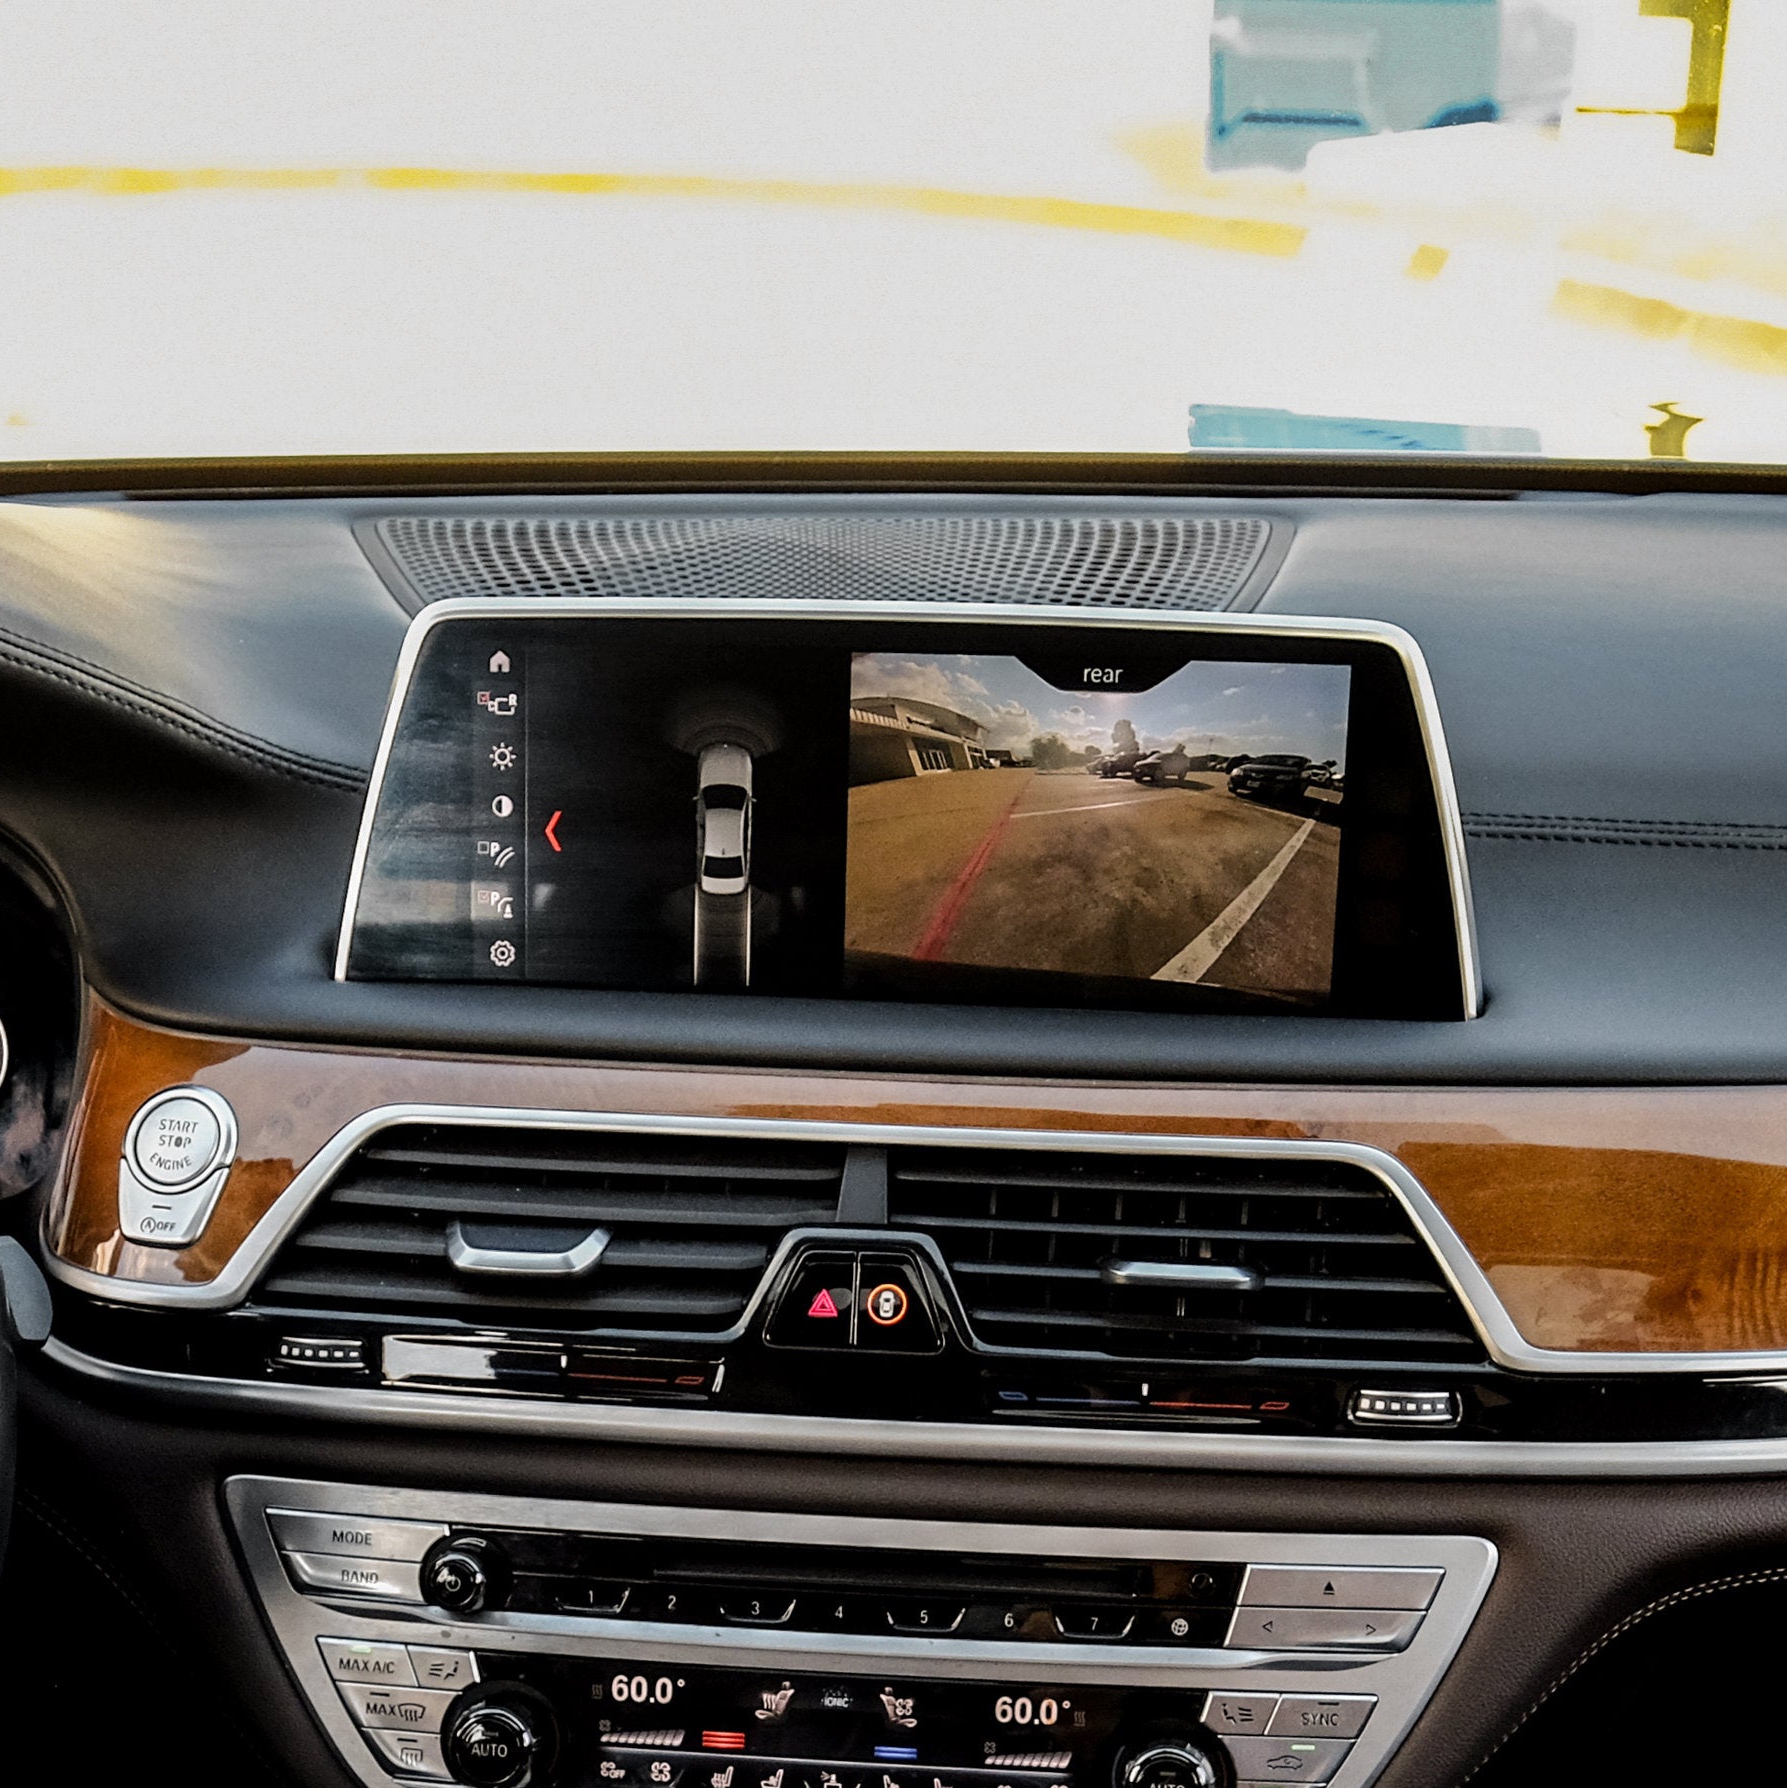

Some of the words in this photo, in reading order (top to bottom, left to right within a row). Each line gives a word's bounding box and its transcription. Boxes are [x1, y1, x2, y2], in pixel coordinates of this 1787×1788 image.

[1083, 667, 1124, 684] rear
[158, 1118, 199, 1134] START
[158, 1134, 192, 1149] STOP
[149, 1152, 193, 1171] ENGINE
[156, 1221, 177, 1231] OFF
[331, 1529, 373, 1546] MODE
[341, 1569, 379, 1585] BAND
[588, 1589, 594, 1604] 1
[668, 1595, 677, 1610] 2
[751, 1601, 760, 1615] 3
[834, 1605, 844, 1619] 4
[919, 1609, 929, 1624] 5
[1004, 1613, 1014, 1627] 6
[1090, 1616, 1099, 1631] 7
[338, 1657, 370, 1672] MAX
[372, 1660, 395, 1674] A/C
[365, 1702, 397, 1716] MAX
[1300, 1712, 1340, 1727] SYNC
[470, 1743, 508, 1758] AUTO
